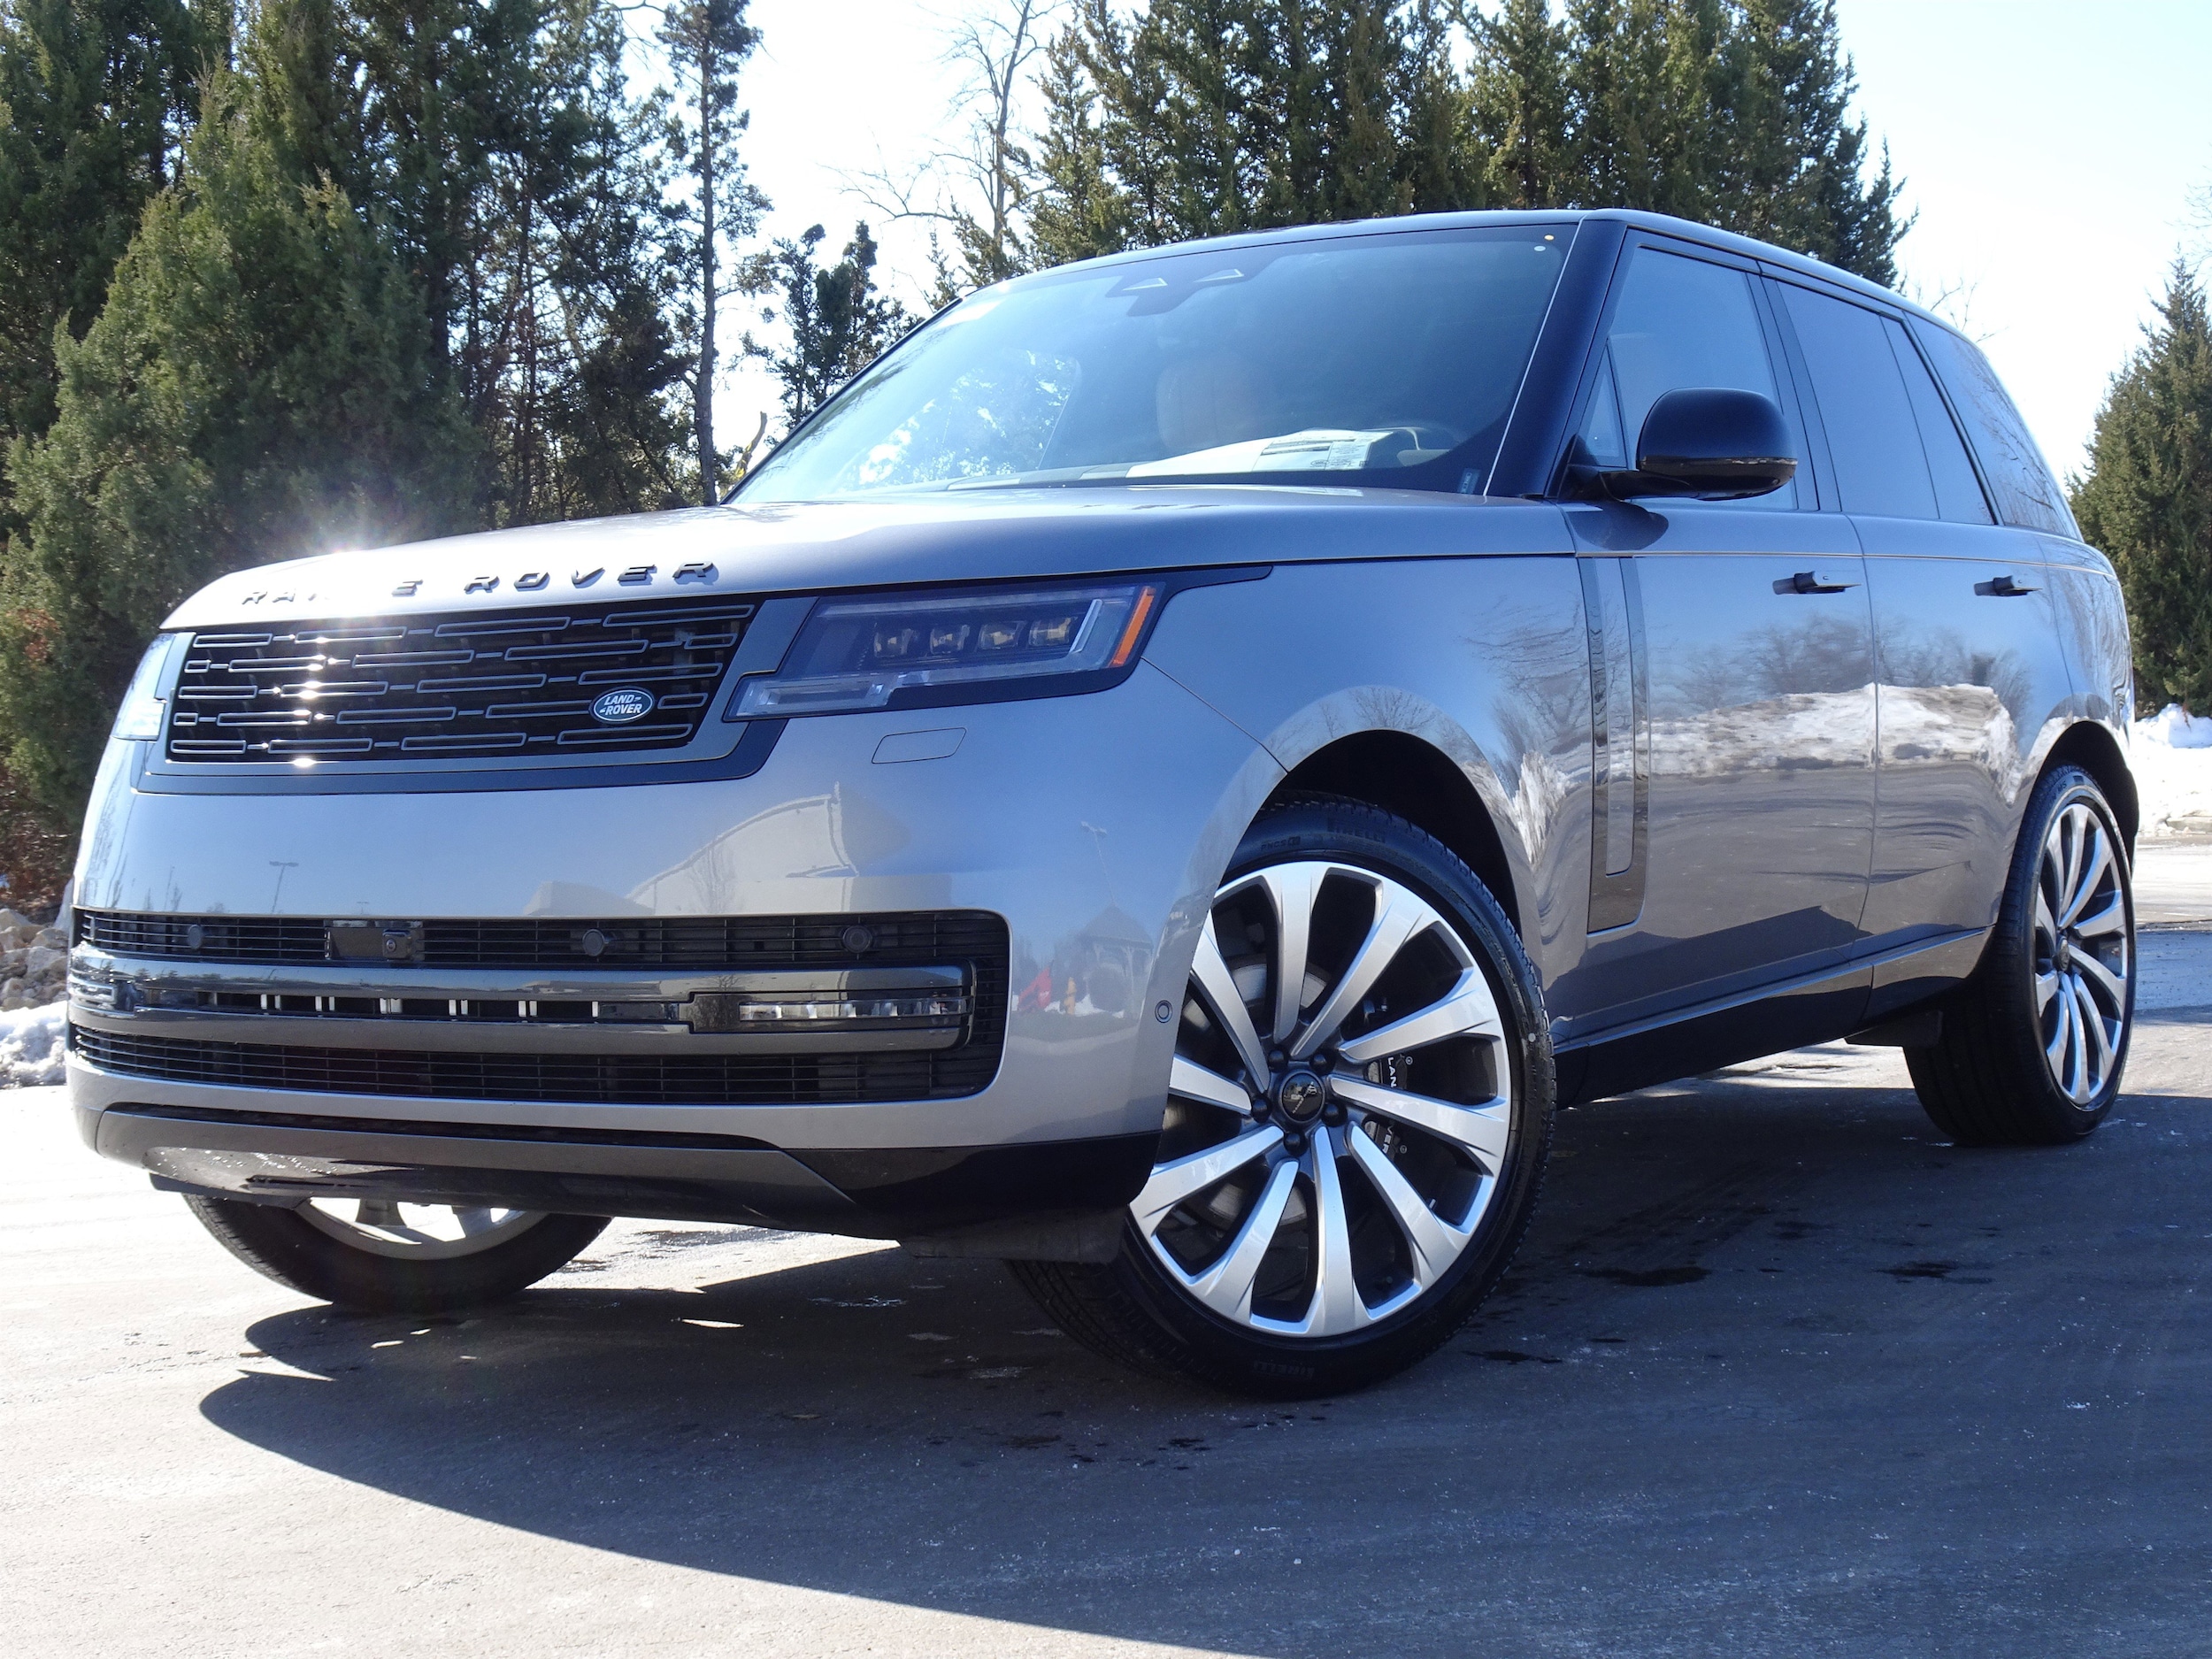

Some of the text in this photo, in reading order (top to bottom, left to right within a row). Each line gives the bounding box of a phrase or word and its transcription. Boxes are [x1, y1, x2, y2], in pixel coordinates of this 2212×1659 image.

[464, 559, 718, 595] ROVER
[604, 695, 635, 706] LAND
[605, 703, 642, 715] ROVER
[1387, 1056, 1397, 1088] LAN
